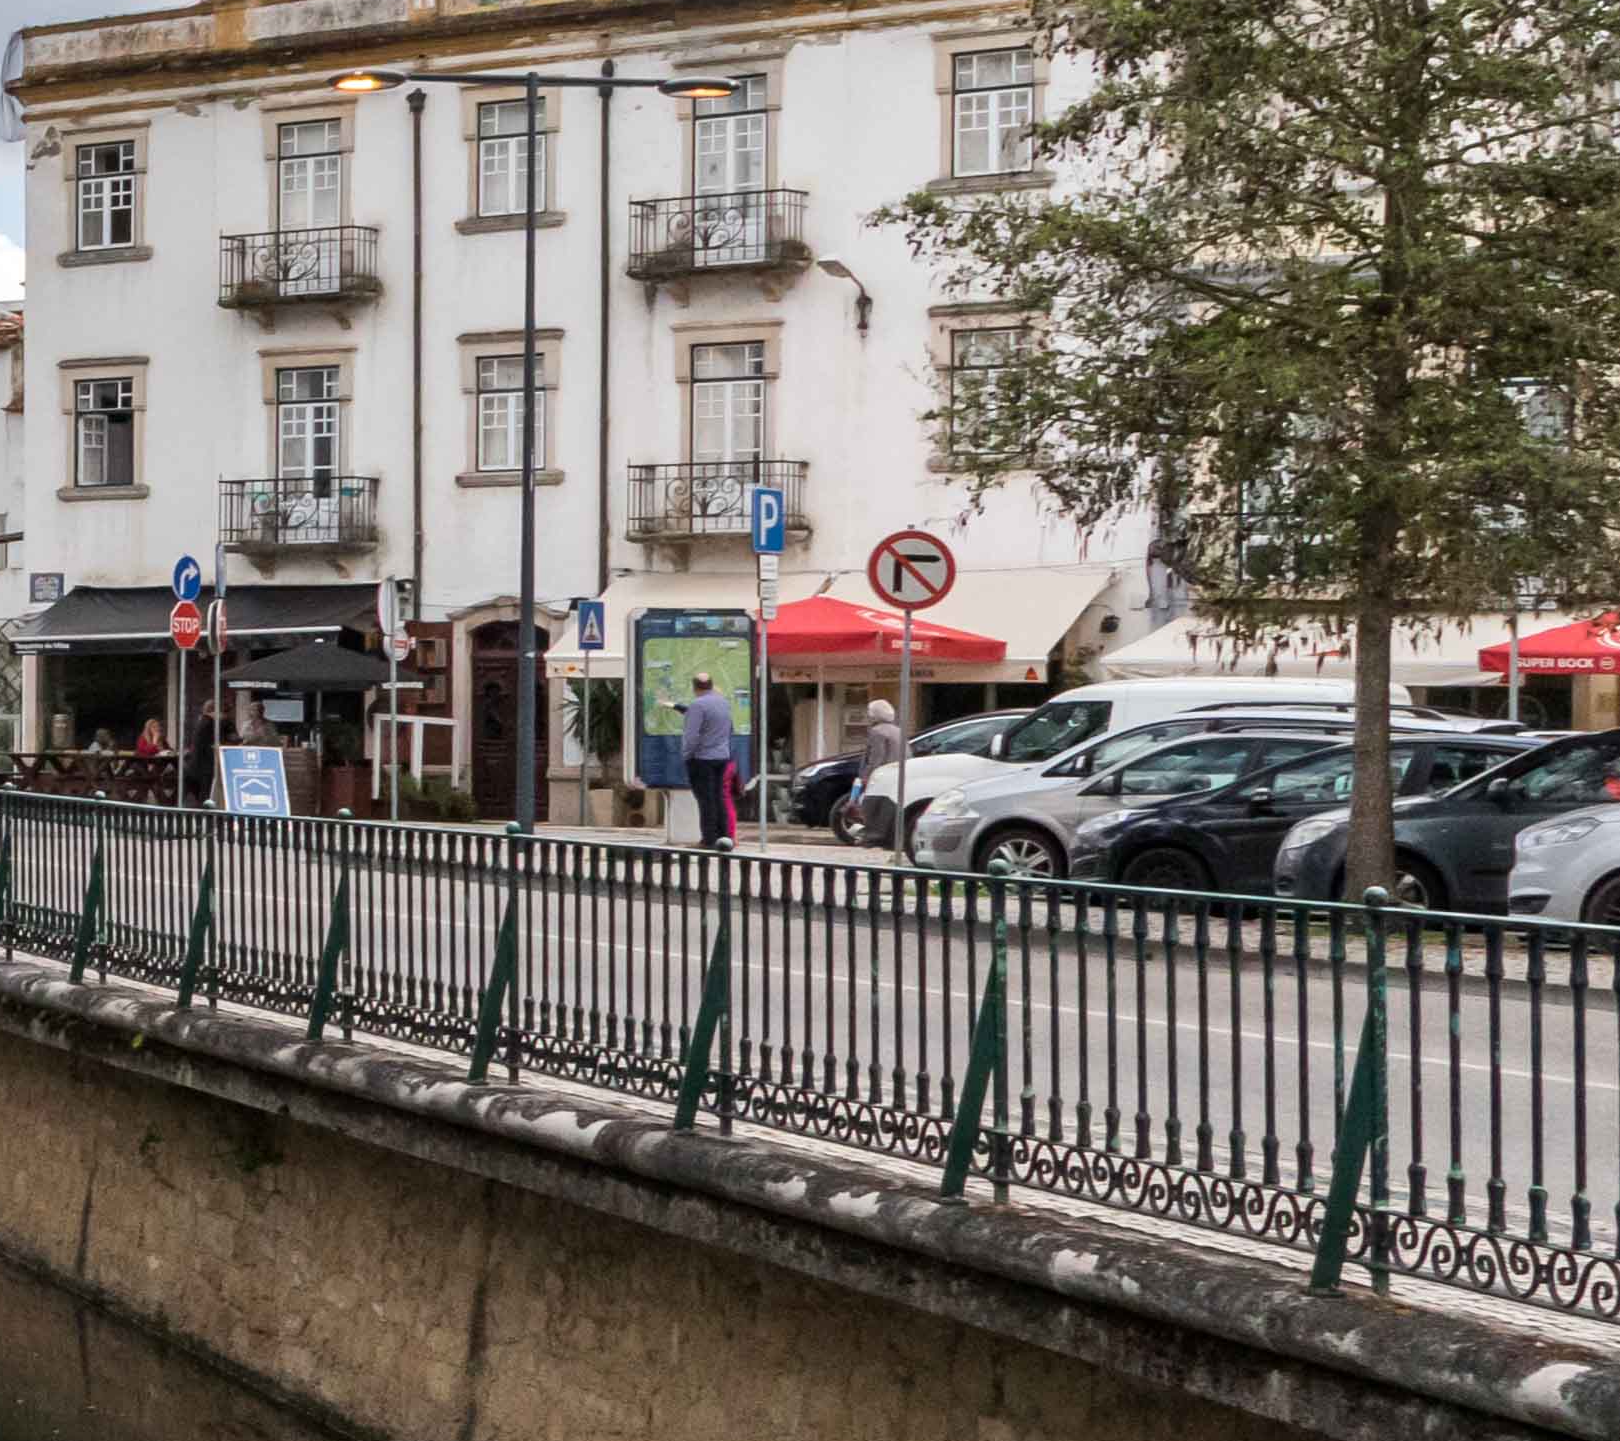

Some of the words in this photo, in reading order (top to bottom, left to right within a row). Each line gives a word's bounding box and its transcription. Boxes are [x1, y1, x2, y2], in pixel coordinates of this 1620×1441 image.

[759, 493, 779, 547] P
[172, 617, 199, 633] STOP
[1517, 657, 1555, 668] SUPER
[1557, 658, 1595, 668] BOCK
